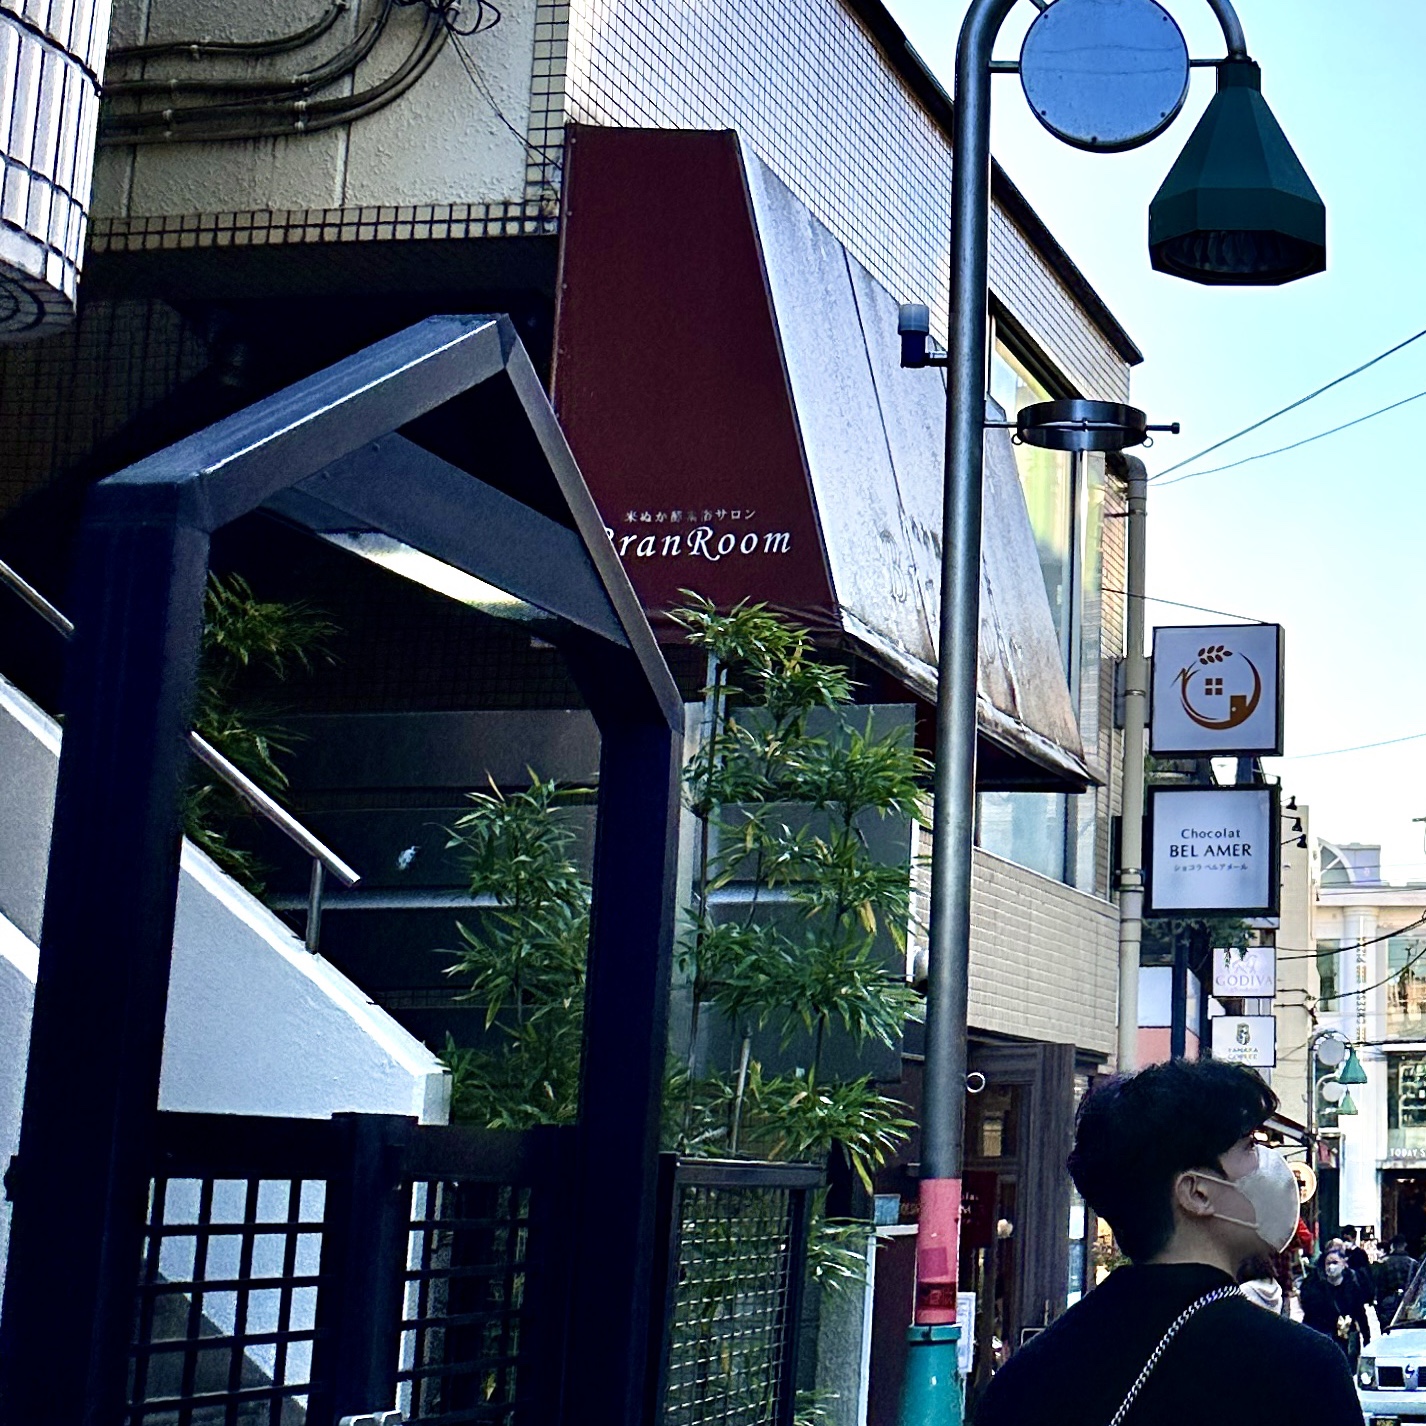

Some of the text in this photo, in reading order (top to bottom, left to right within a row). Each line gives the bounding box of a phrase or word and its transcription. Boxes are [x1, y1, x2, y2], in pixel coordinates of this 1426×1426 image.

[1181, 828, 1241, 839] Chocolat
[1169, 843, 1252, 858] BEL AMER
[1215, 975, 1273, 987] GODIVA
